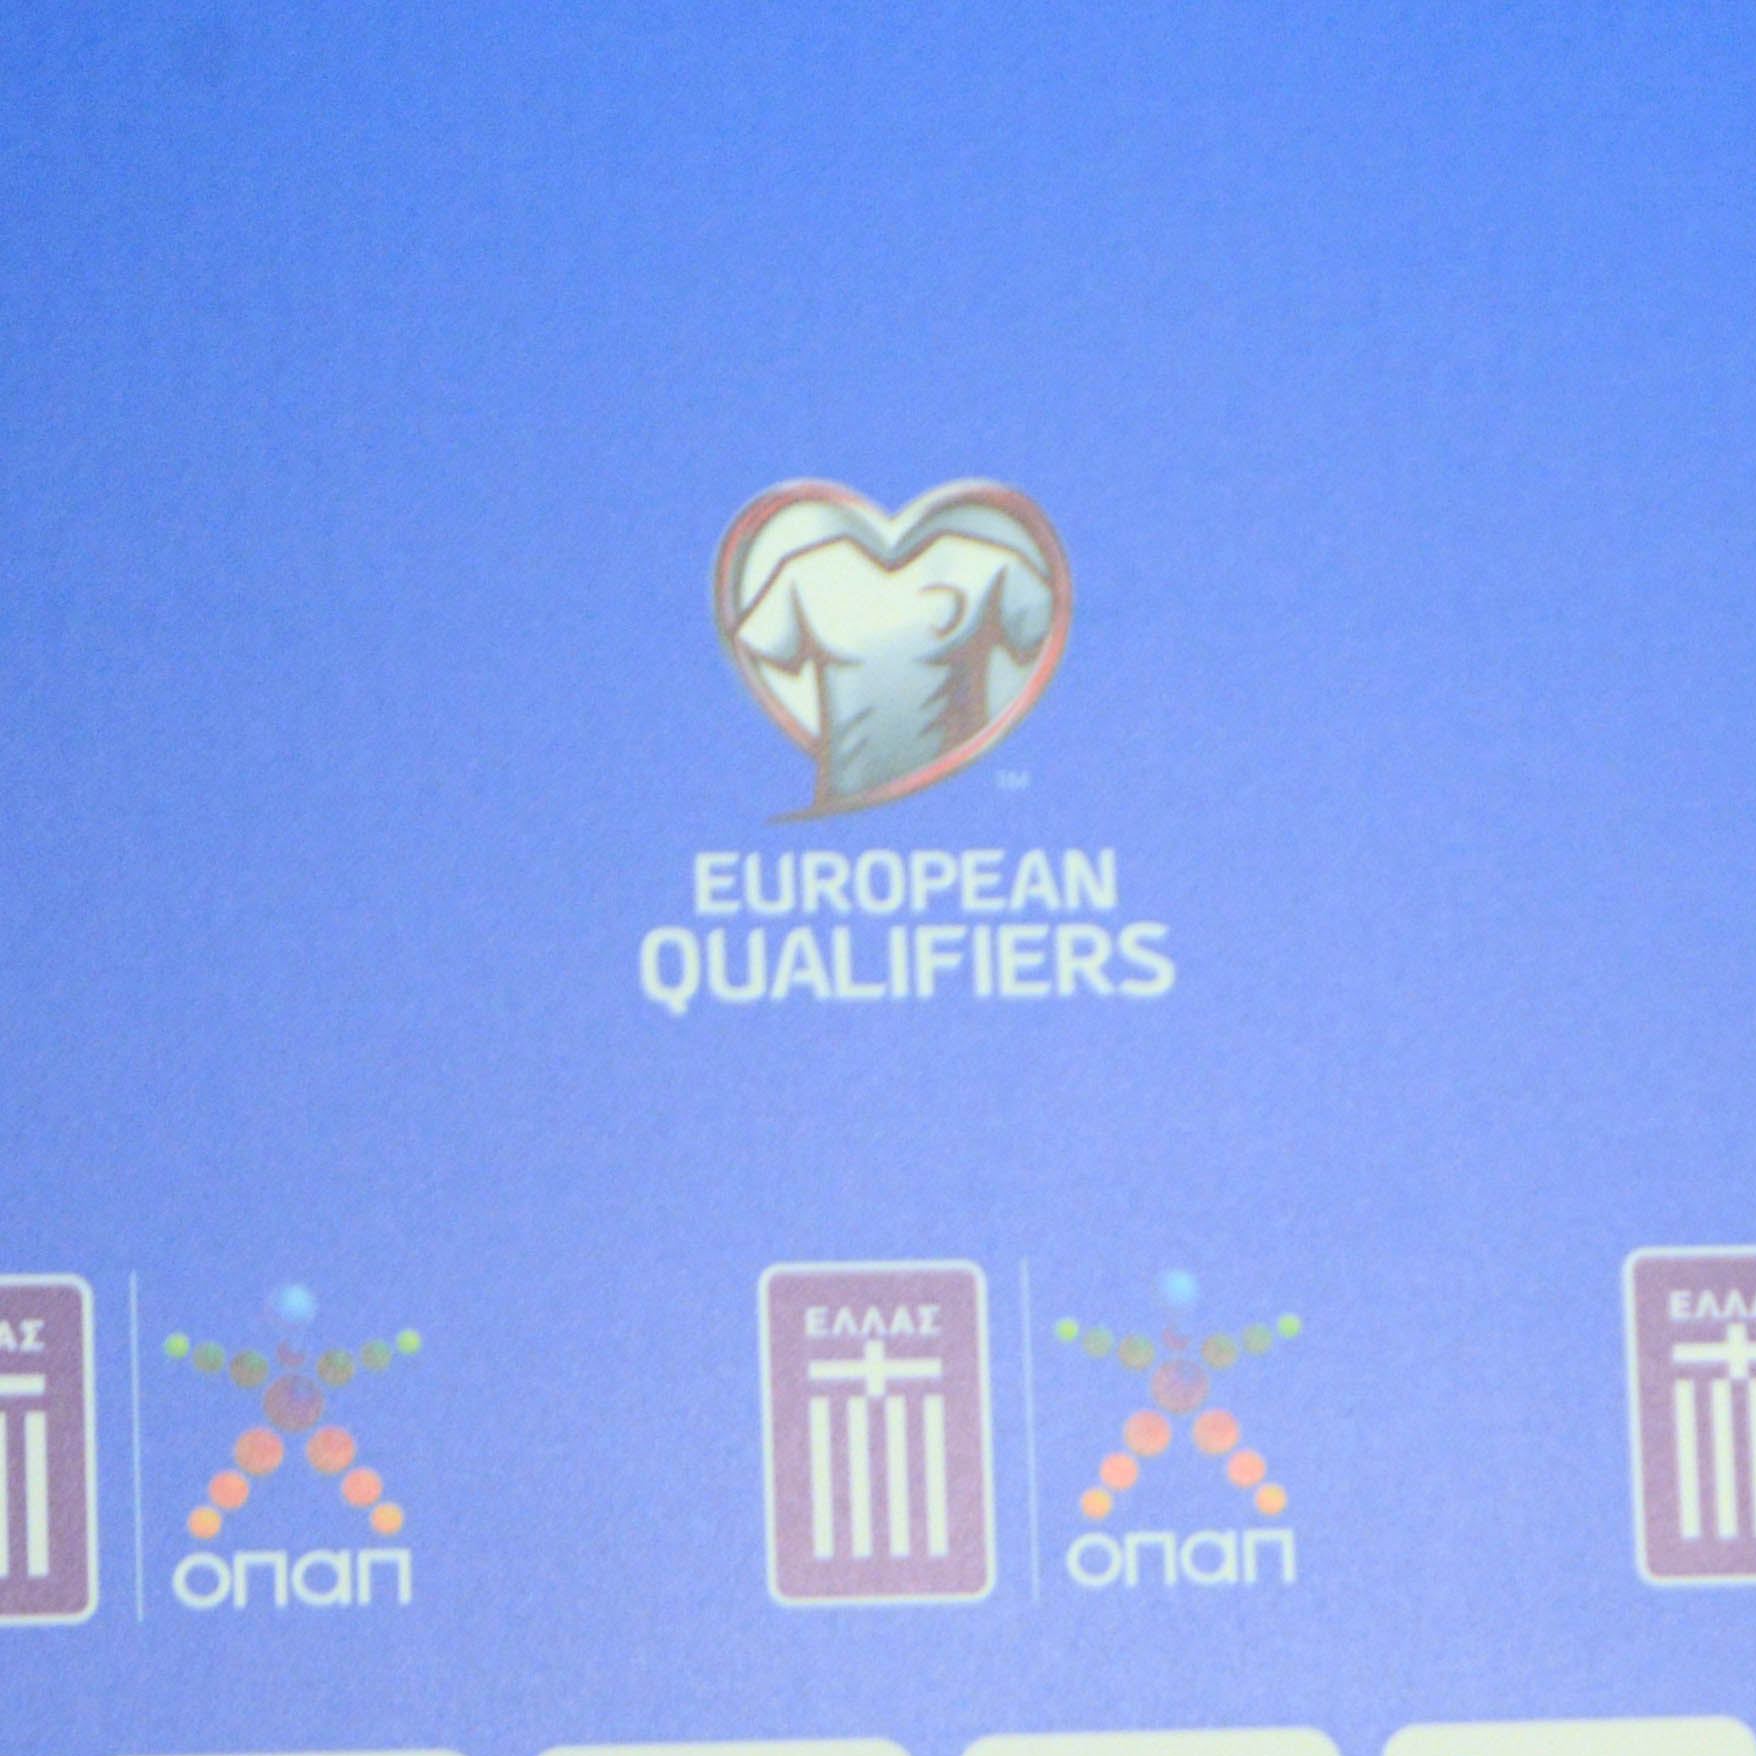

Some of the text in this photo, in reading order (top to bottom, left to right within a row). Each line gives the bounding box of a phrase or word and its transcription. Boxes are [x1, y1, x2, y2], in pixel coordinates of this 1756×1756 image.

[693, 849, 1118, 917] EUROPEAN
[638, 921, 1177, 1017] QUALIFIERS
[805, 1304, 942, 1337] ΕΛΛΑΣ
